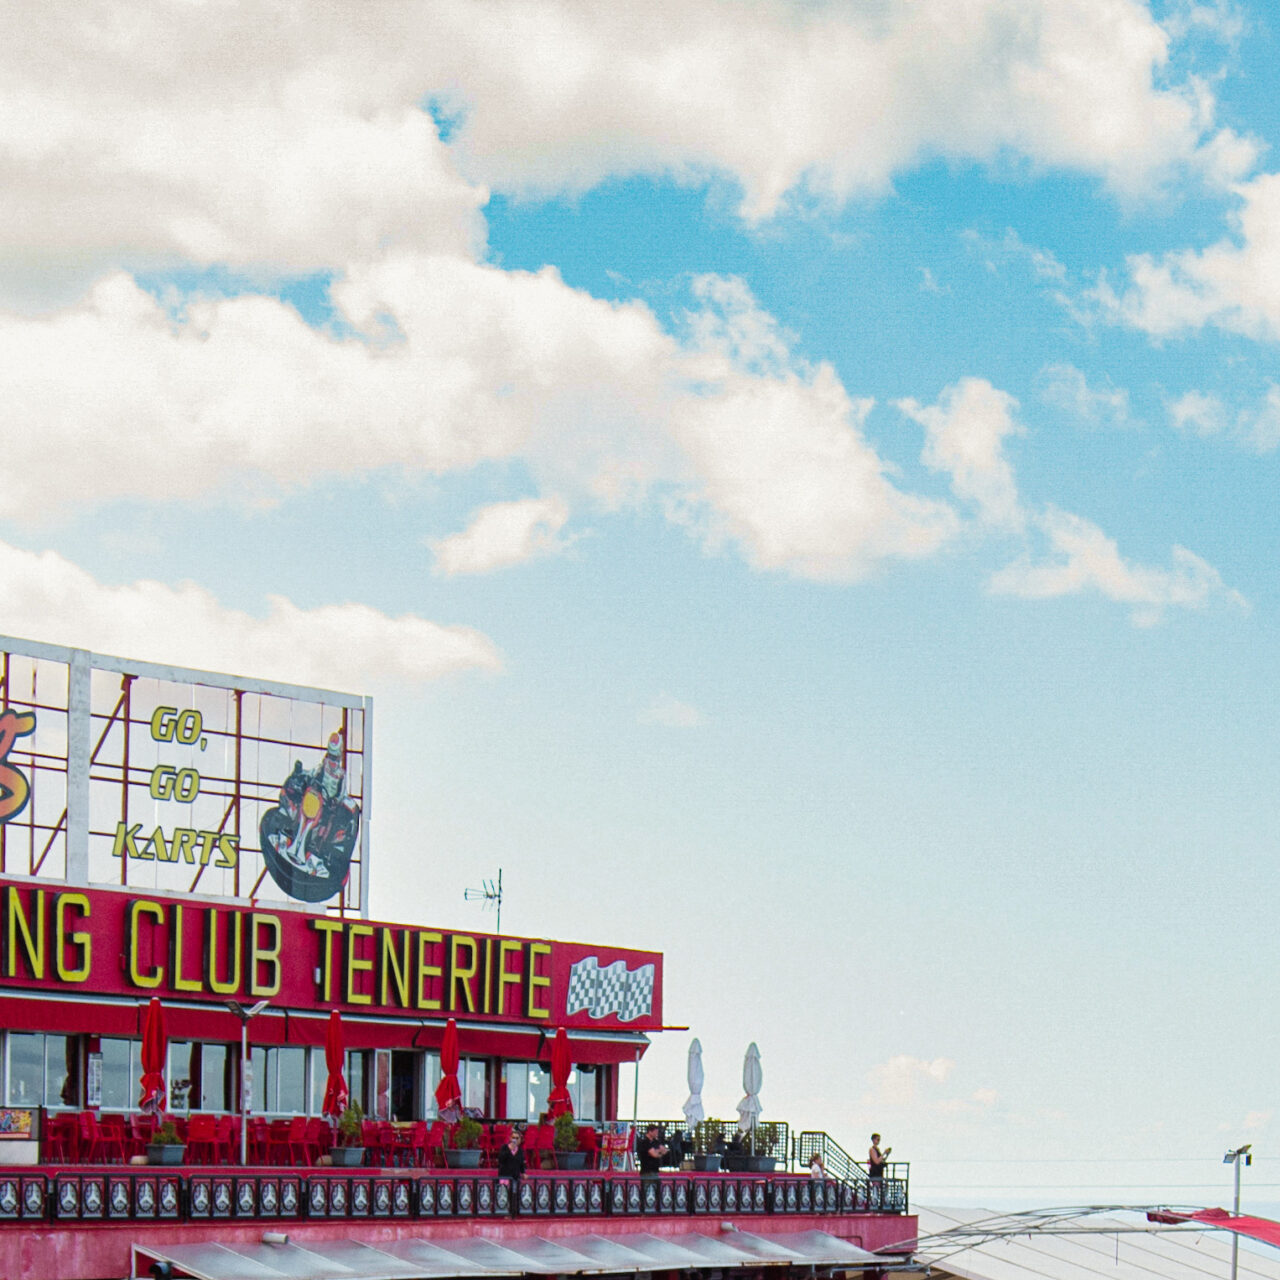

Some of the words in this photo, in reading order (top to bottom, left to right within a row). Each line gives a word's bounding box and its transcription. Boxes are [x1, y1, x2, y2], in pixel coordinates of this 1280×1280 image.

[150, 705, 207, 751] GO,
[149, 764, 200, 803] GO
[112, 821, 240, 869] KARTS
[127, 899, 282, 998] CLUB
[311, 918, 551, 1019] TENERIFE
